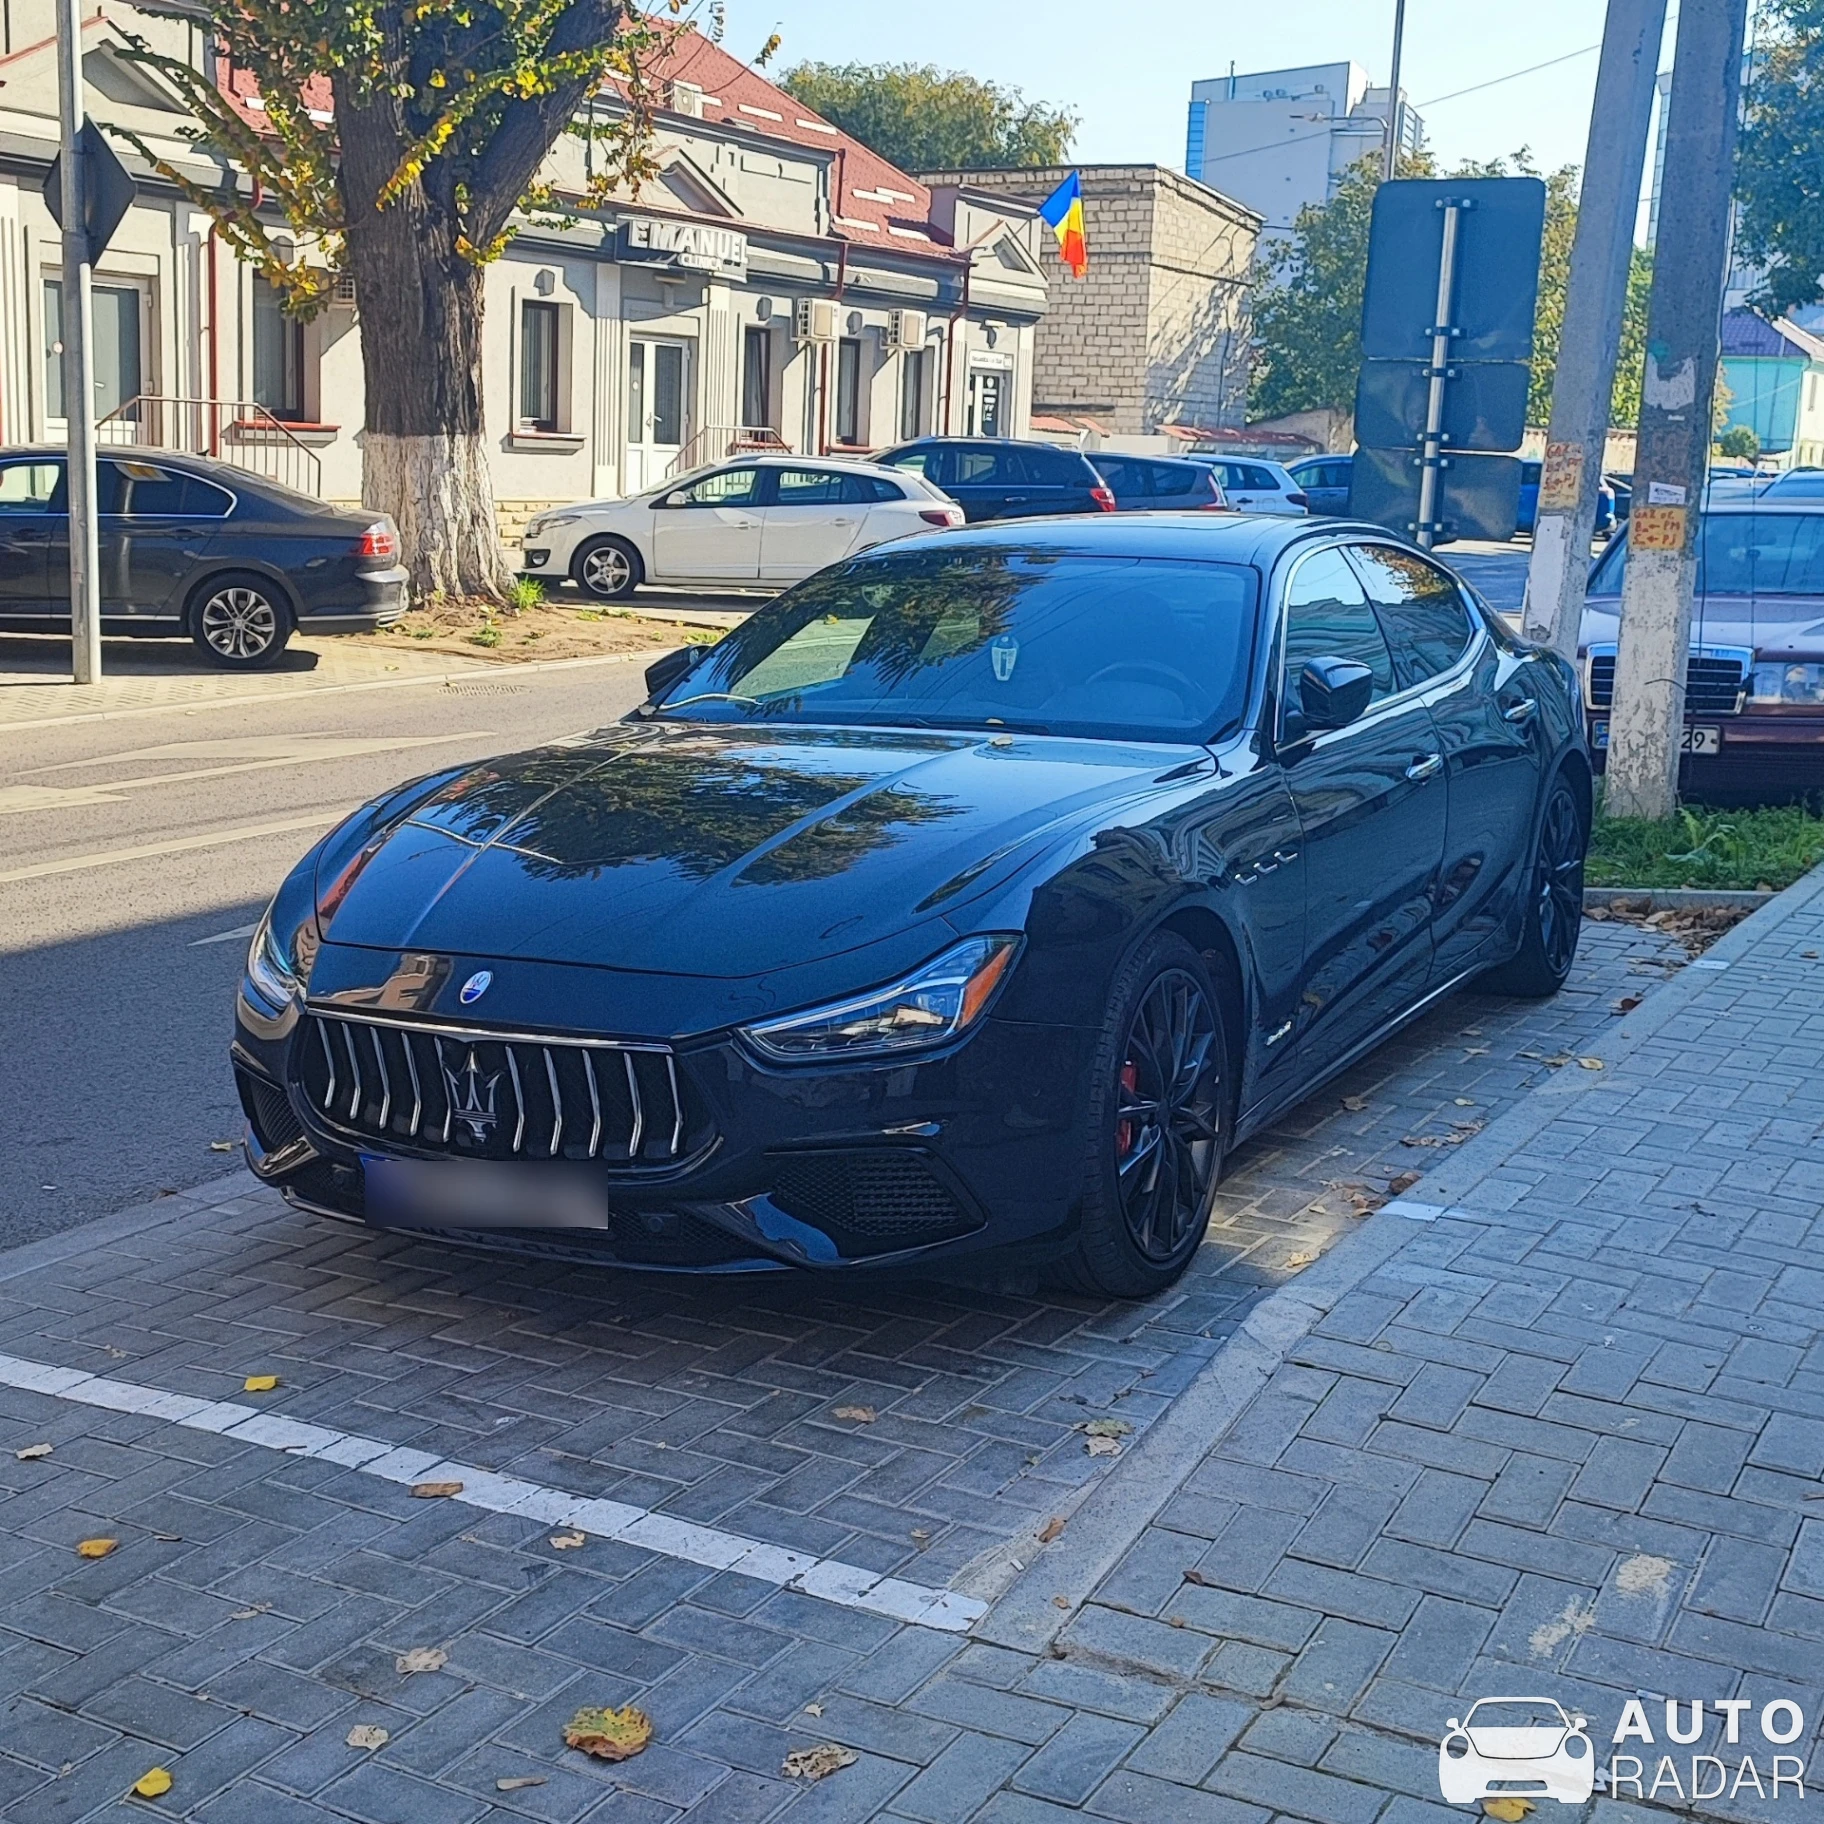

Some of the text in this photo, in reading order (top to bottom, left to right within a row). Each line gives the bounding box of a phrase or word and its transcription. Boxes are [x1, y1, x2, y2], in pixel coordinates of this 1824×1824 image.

[629, 220, 748, 263] EMANUEL
[678, 253, 722, 271] CLINICA
[1633, 508, 1657, 519] GAZ
[1681, 731, 1705, 749] 29
